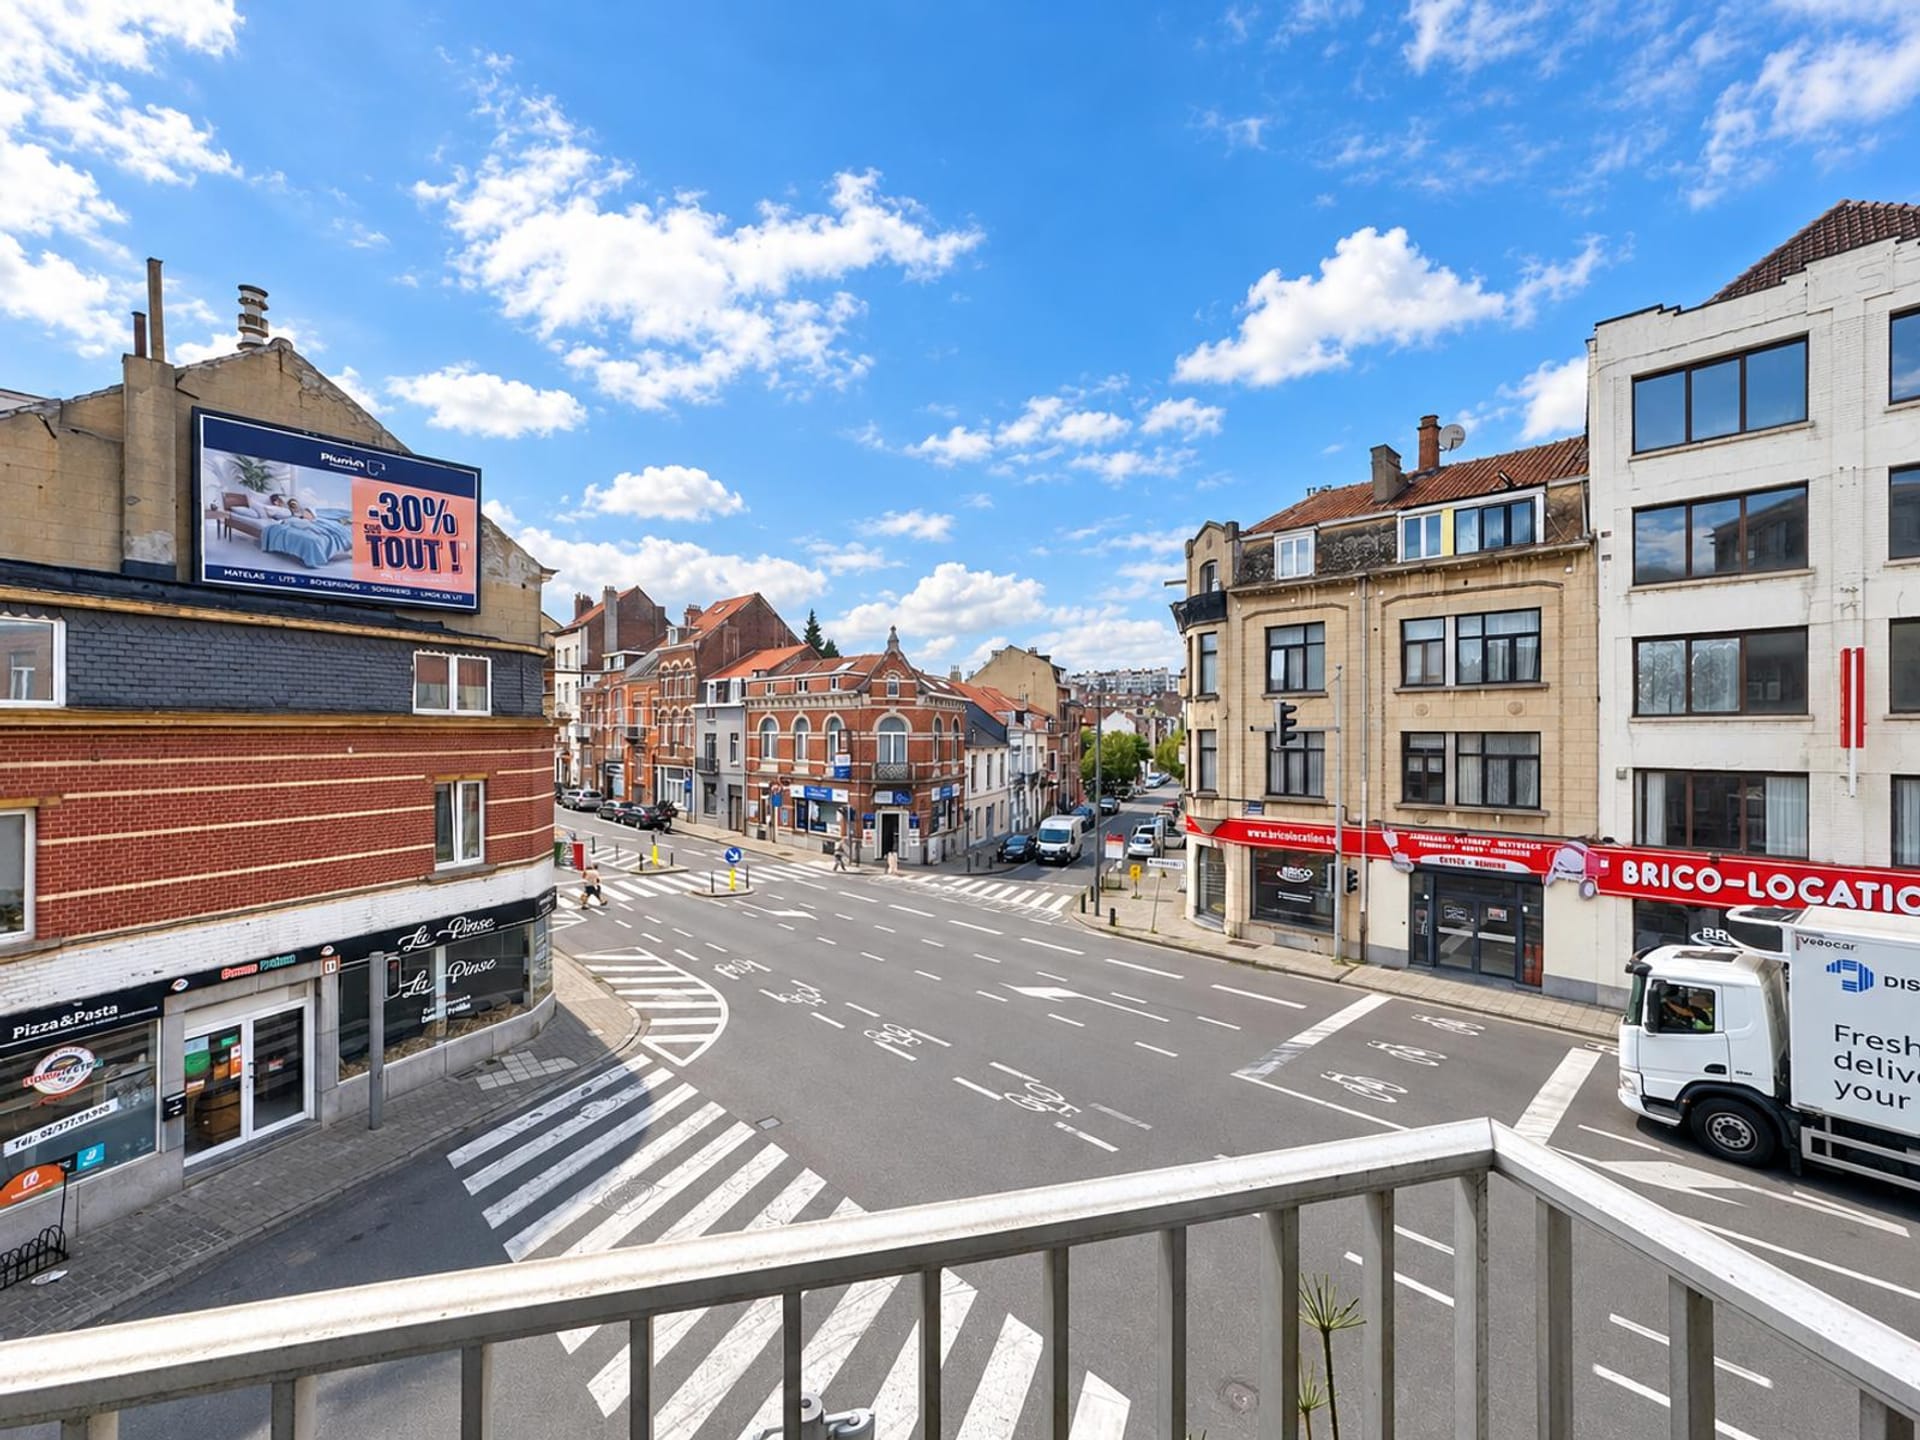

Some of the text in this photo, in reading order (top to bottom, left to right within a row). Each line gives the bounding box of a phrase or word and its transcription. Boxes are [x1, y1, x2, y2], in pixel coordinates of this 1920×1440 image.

[368, 491, 458, 536] -30%
[364, 533, 443, 573] TOUT
[223, 568, 265, 580] MATELAS
[397, 925, 436, 952] La
[400, 969, 435, 999] La
[1835, 1023, 1920, 1056] Fresh
[1834, 1051, 1920, 1084] deliv
[1834, 1079, 1911, 1110] your
